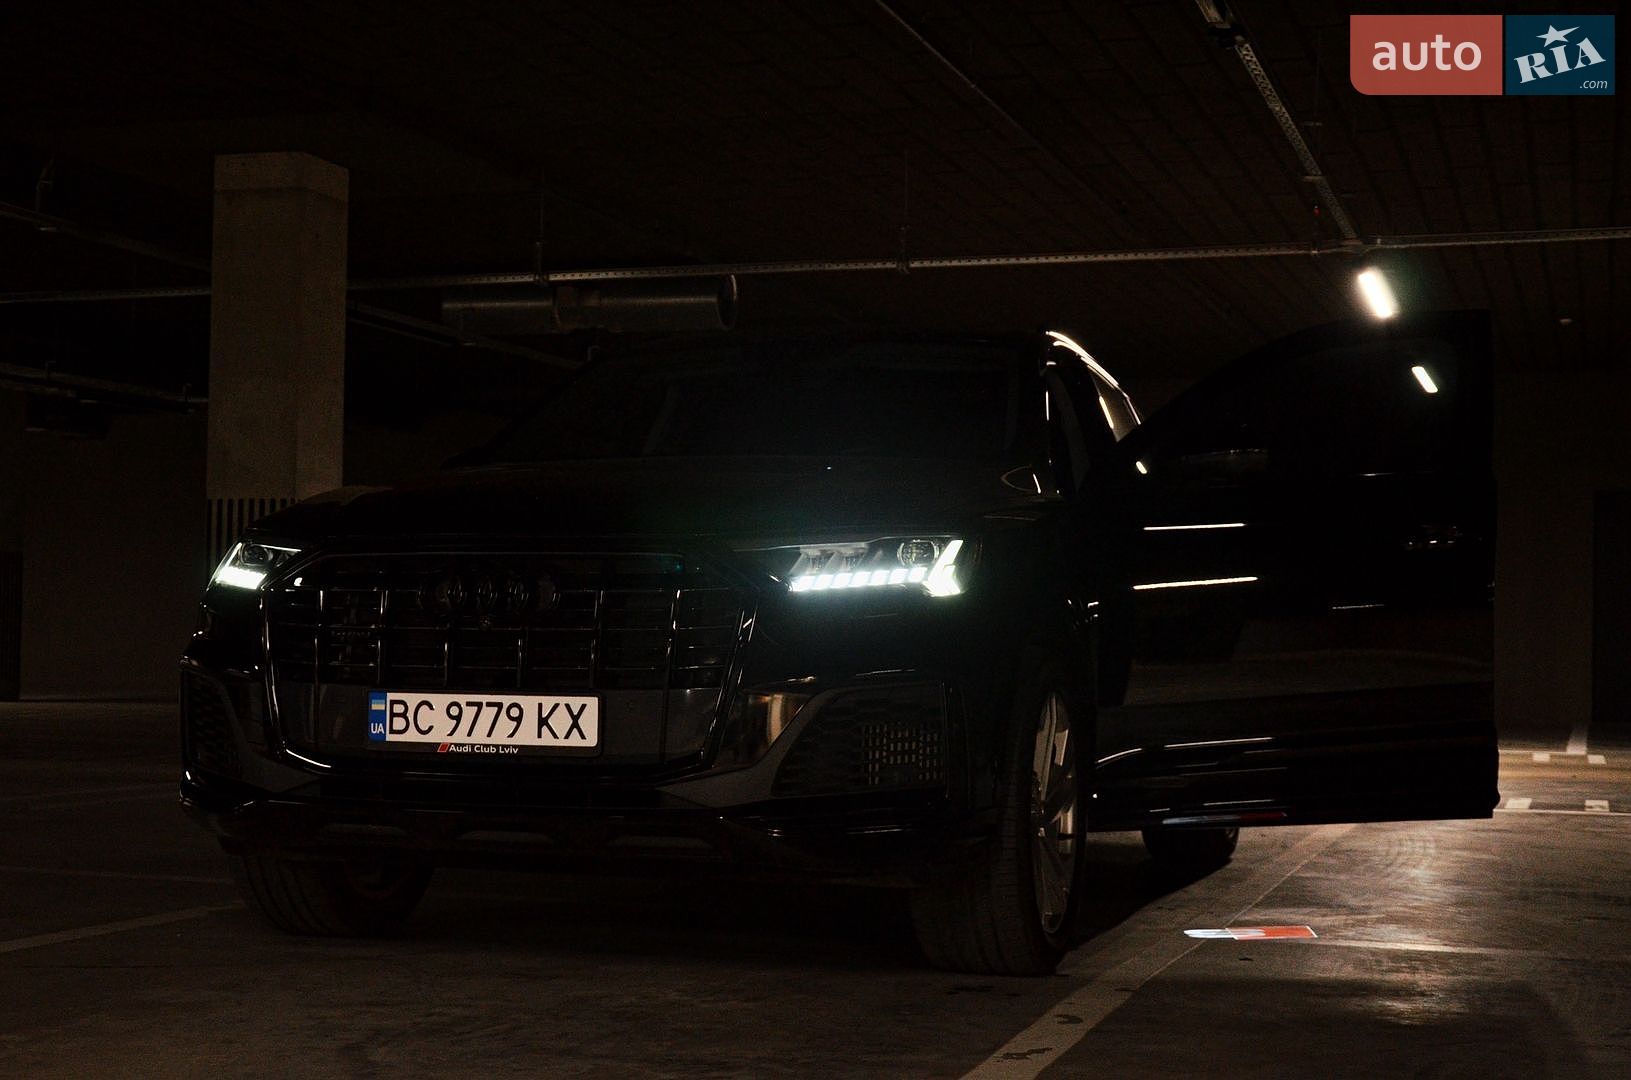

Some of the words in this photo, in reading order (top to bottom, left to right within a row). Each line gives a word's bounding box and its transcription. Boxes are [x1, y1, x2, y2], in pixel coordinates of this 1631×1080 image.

[388, 699, 435, 736] BC
[445, 701, 524, 738] 9779
[537, 702, 587, 740] KX
[371, 723, 385, 734] UA
[449, 744, 472, 753] Audi
[474, 744, 497, 753] Club
[499, 745, 519, 754] Lviv
